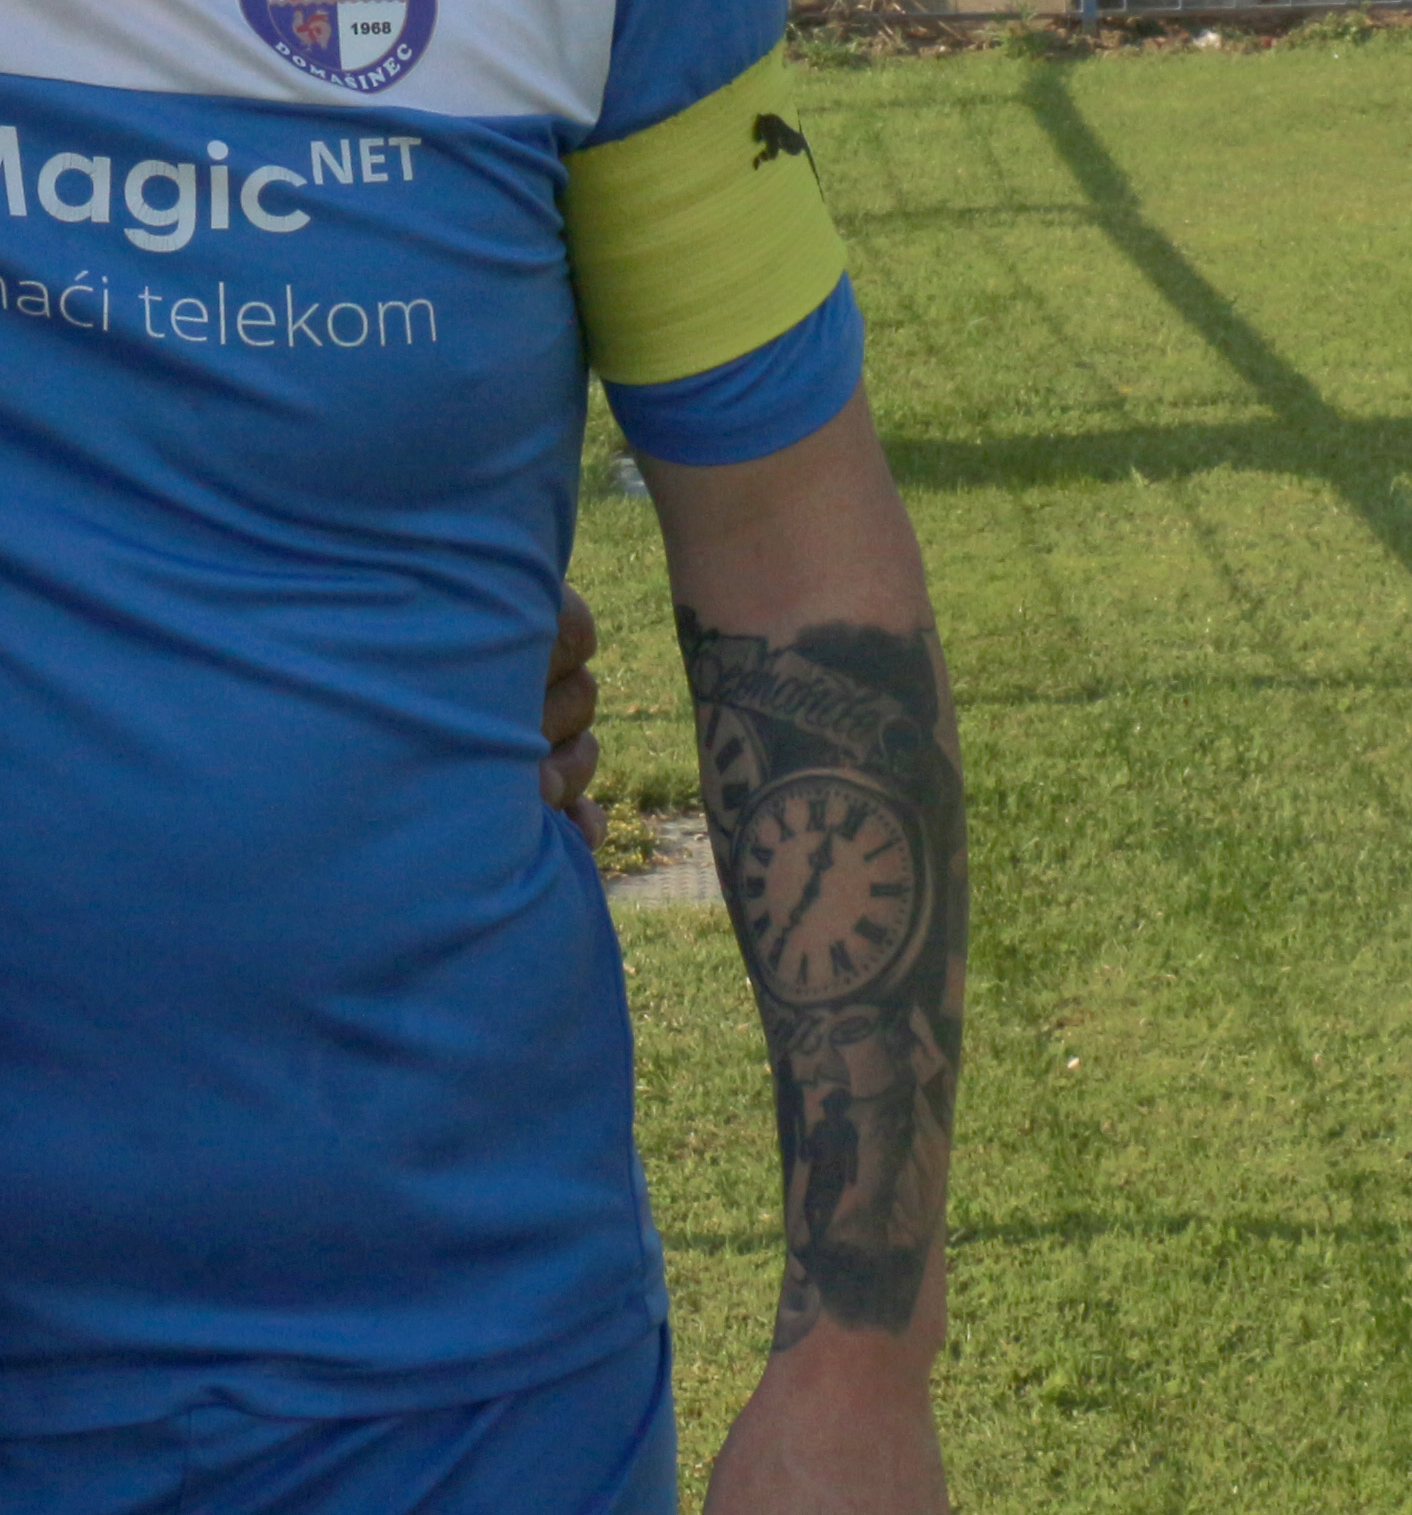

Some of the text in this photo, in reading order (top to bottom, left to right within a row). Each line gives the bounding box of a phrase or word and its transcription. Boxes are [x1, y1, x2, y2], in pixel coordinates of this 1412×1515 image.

[350, 21, 392, 35] 1968
[275, 41, 413, 90] DOMAŠINEC
[138, 281, 439, 348] telekom
